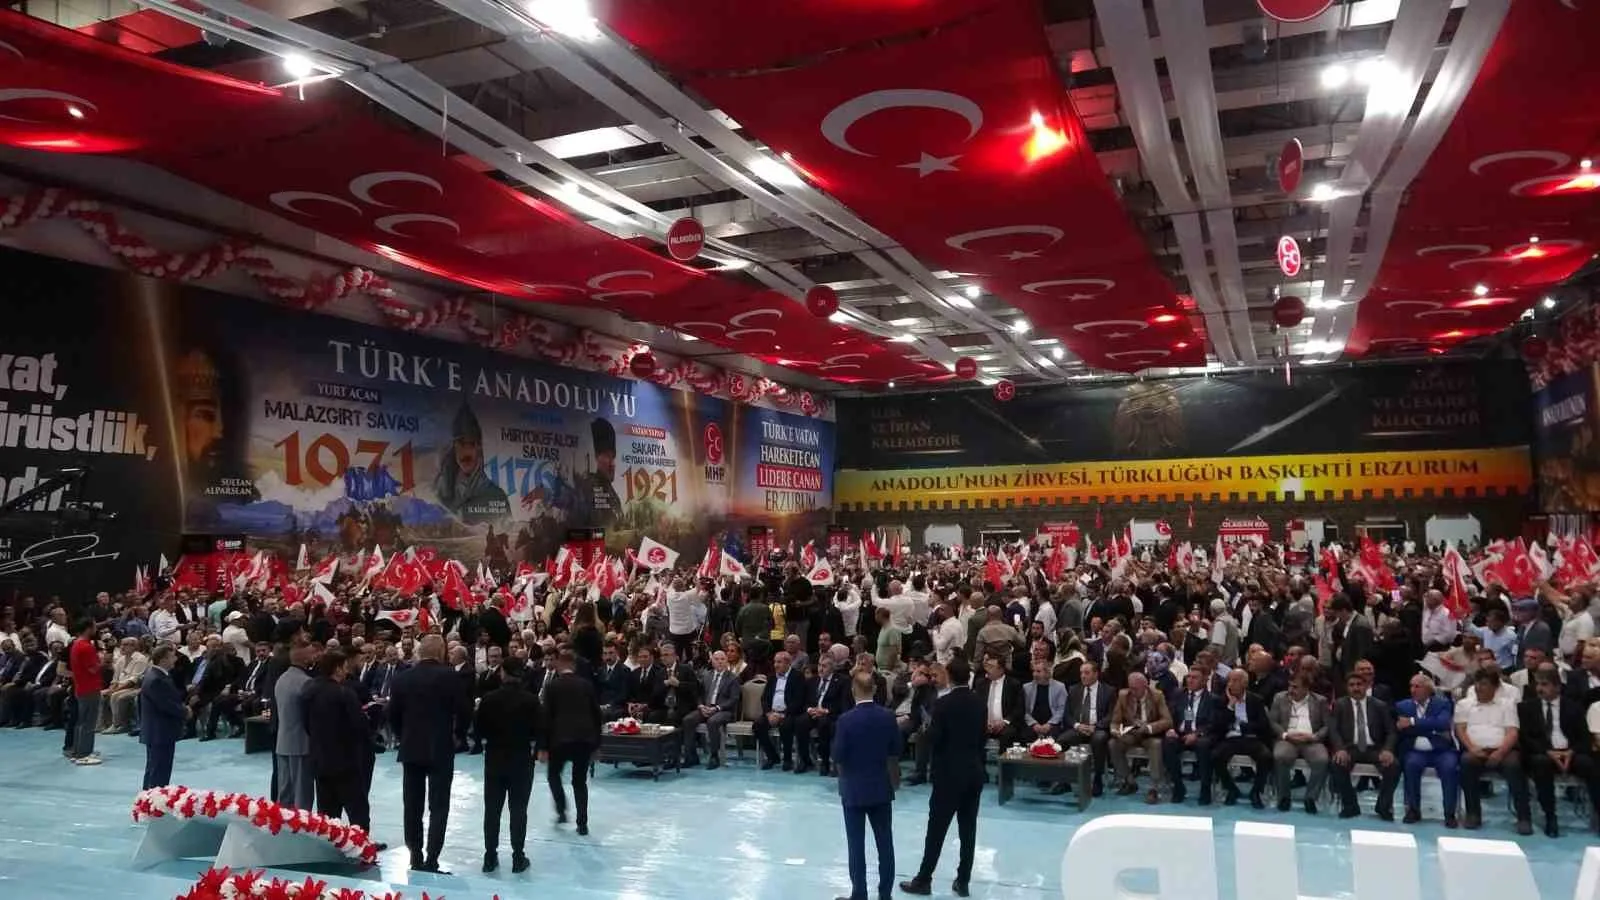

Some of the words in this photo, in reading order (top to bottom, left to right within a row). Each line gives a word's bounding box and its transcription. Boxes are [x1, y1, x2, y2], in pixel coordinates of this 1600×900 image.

[317, 383, 346, 398] YURT
[328, 339, 462, 392] TÜRK'E
[473, 367, 638, 418] ANADOLU'YU
[264, 399, 363, 427] MALAZGİRT
[631, 441, 666, 457] SAKARYA
[760, 445, 804, 467] HAREKETE
[804, 451, 821, 468] CAN
[273, 430, 416, 493] 1071
[705, 465, 725, 481] MHP
[622, 466, 678, 505] 1921
[760, 466, 793, 488] LİDERE
[793, 473, 821, 490] CANAN
[869, 472, 1009, 492] ANADOLU'NUN
[1013, 468, 1092, 488] ZİRVESİ,
[1096, 461, 1232, 485] TÜRKLÜĞÜN
[1240, 459, 1353, 483] BAŞKENTİ
[1360, 459, 1480, 478] ERZURUM
[765, 490, 816, 513] ERZURUM
